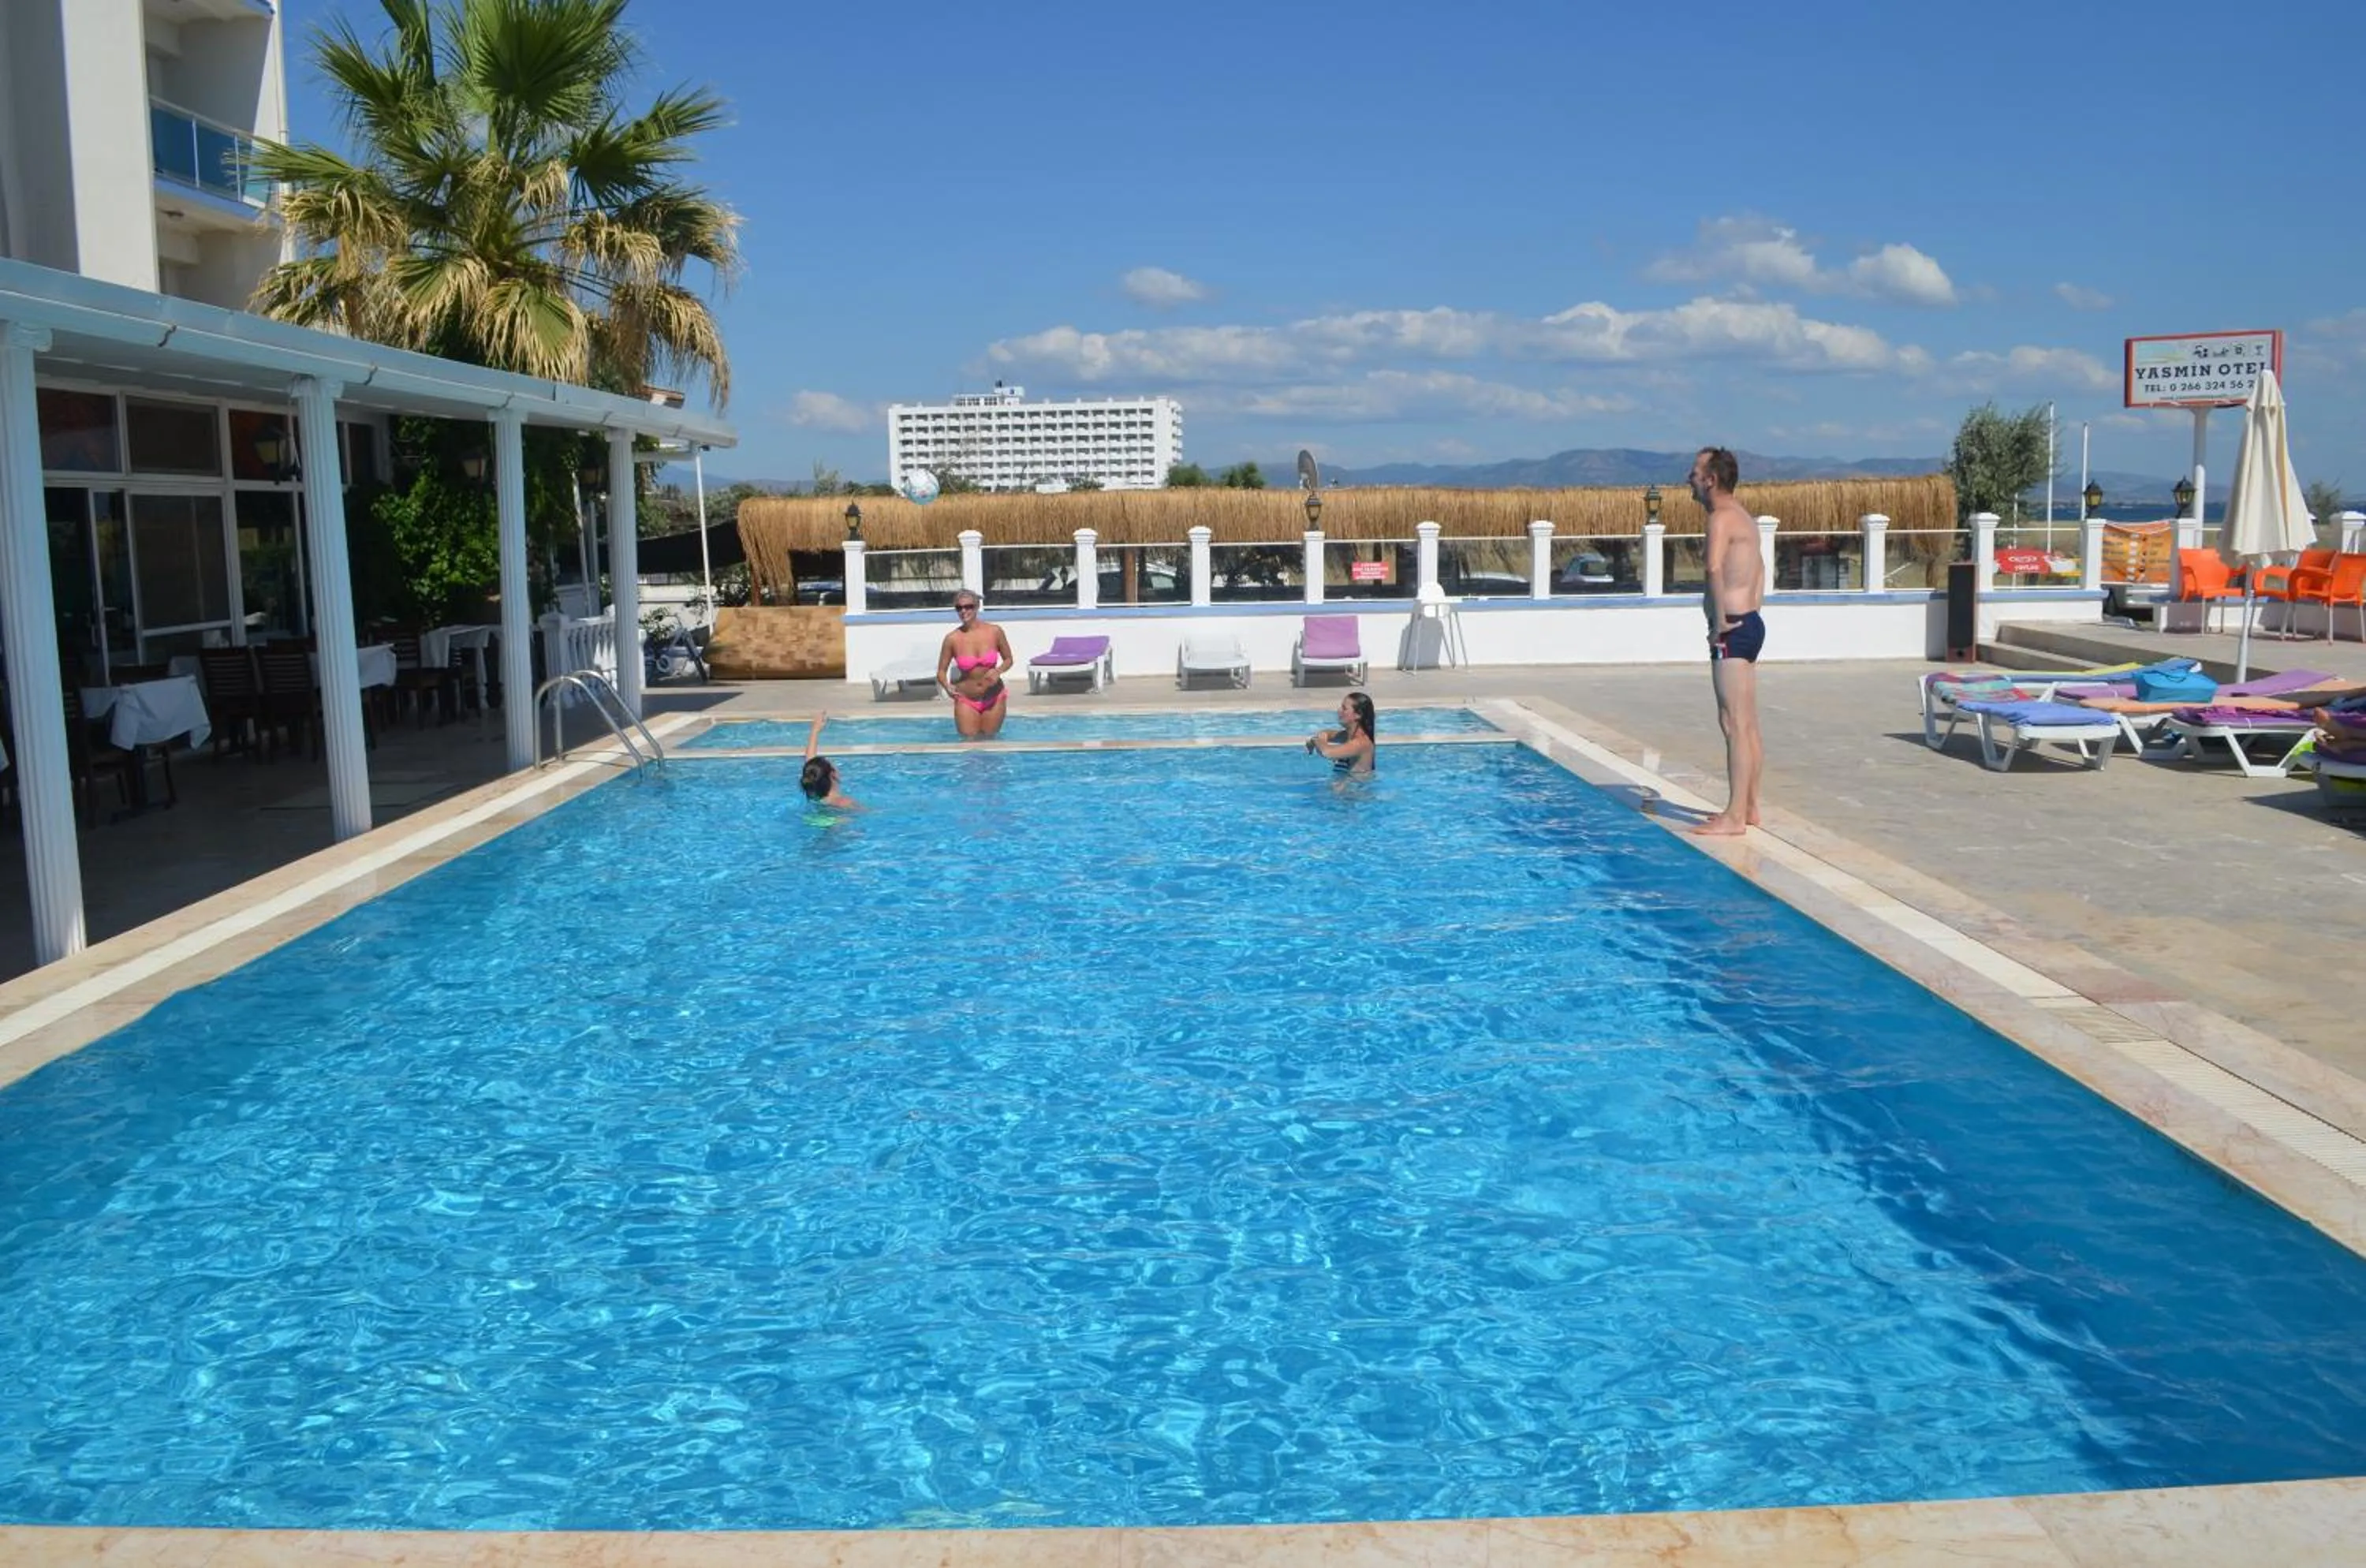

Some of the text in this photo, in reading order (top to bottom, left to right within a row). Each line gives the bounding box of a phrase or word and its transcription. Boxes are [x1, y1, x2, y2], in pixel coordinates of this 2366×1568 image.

[2144, 383, 2166, 392] TEL:
[2170, 383, 2177, 391] 0
[2181, 382, 2201, 390] 266
[2205, 381, 2225, 390] 324
[2230, 380, 2243, 389] 56
